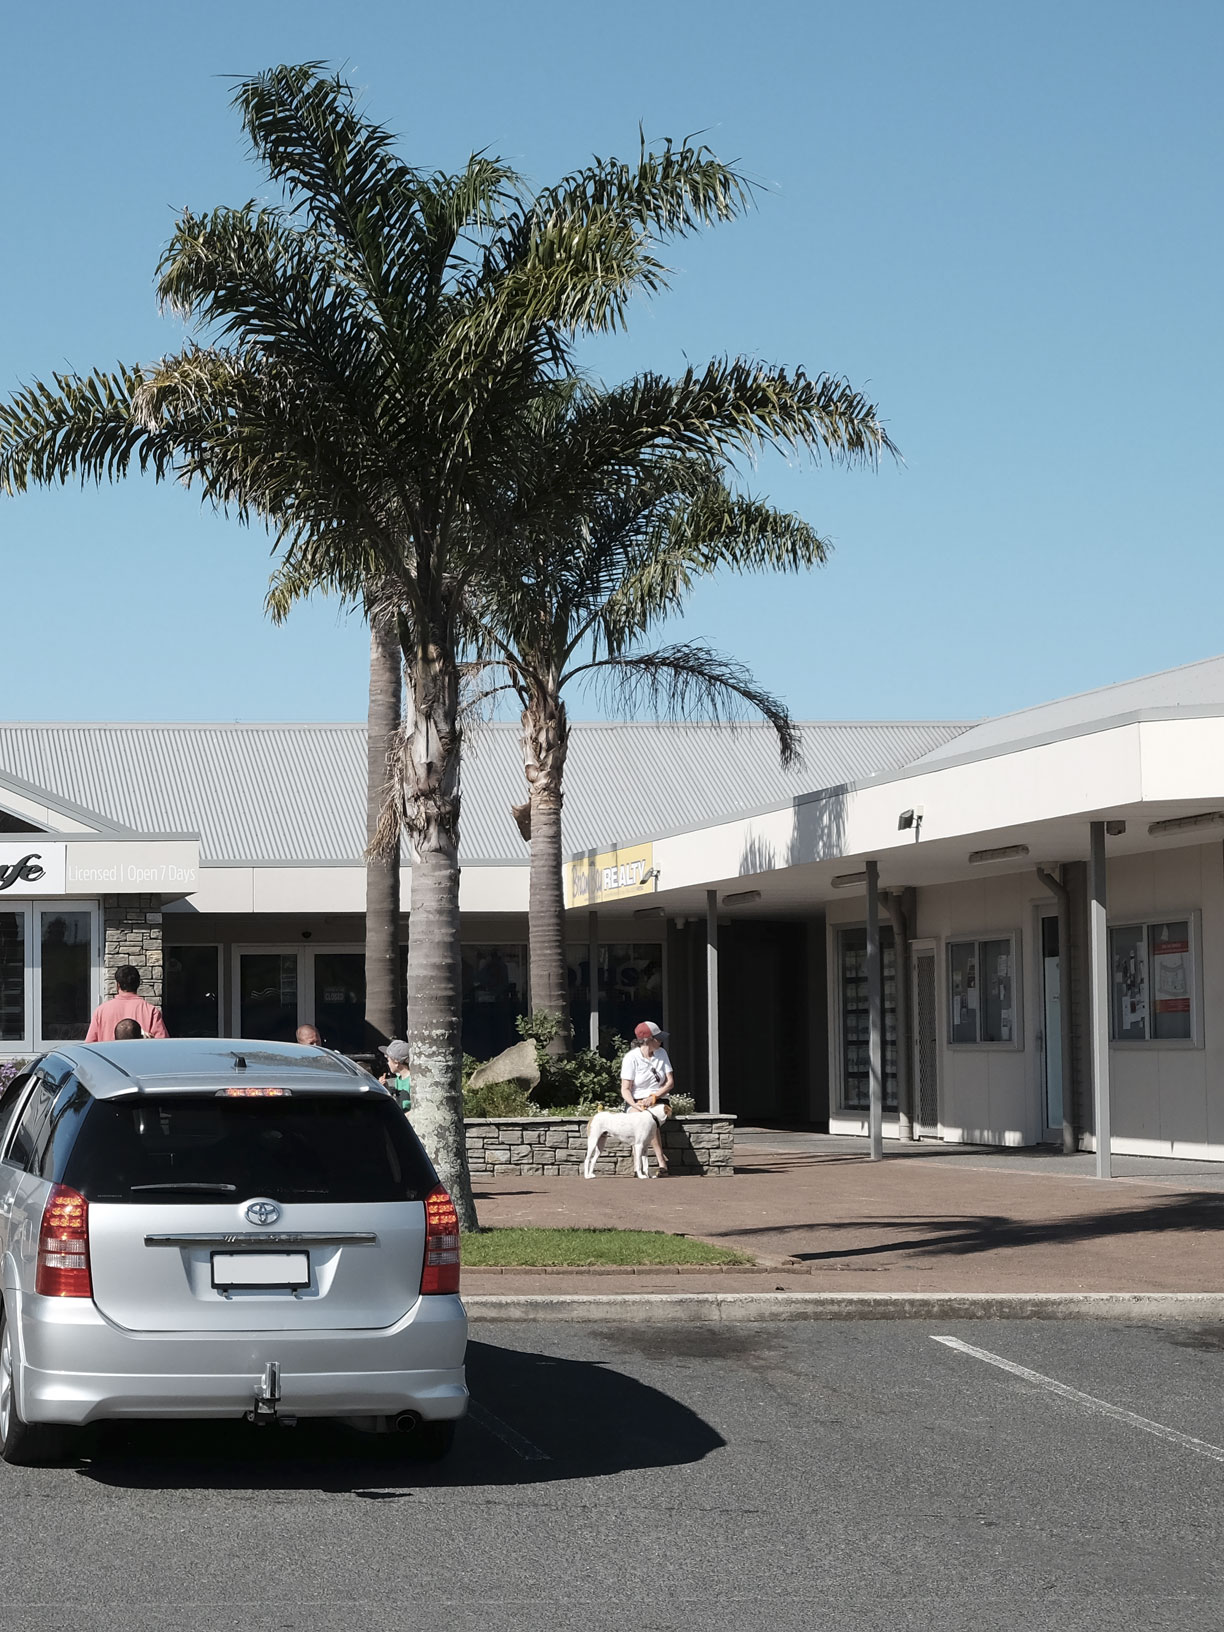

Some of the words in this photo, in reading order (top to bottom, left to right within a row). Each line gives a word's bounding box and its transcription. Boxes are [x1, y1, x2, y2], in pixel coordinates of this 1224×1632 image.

[69, 865, 117, 881] Licensed
[127, 865, 158, 883] Open
[160, 865, 167, 881] 7
[168, 865, 196, 883] Days
[603, 859, 646, 891] REALTY
